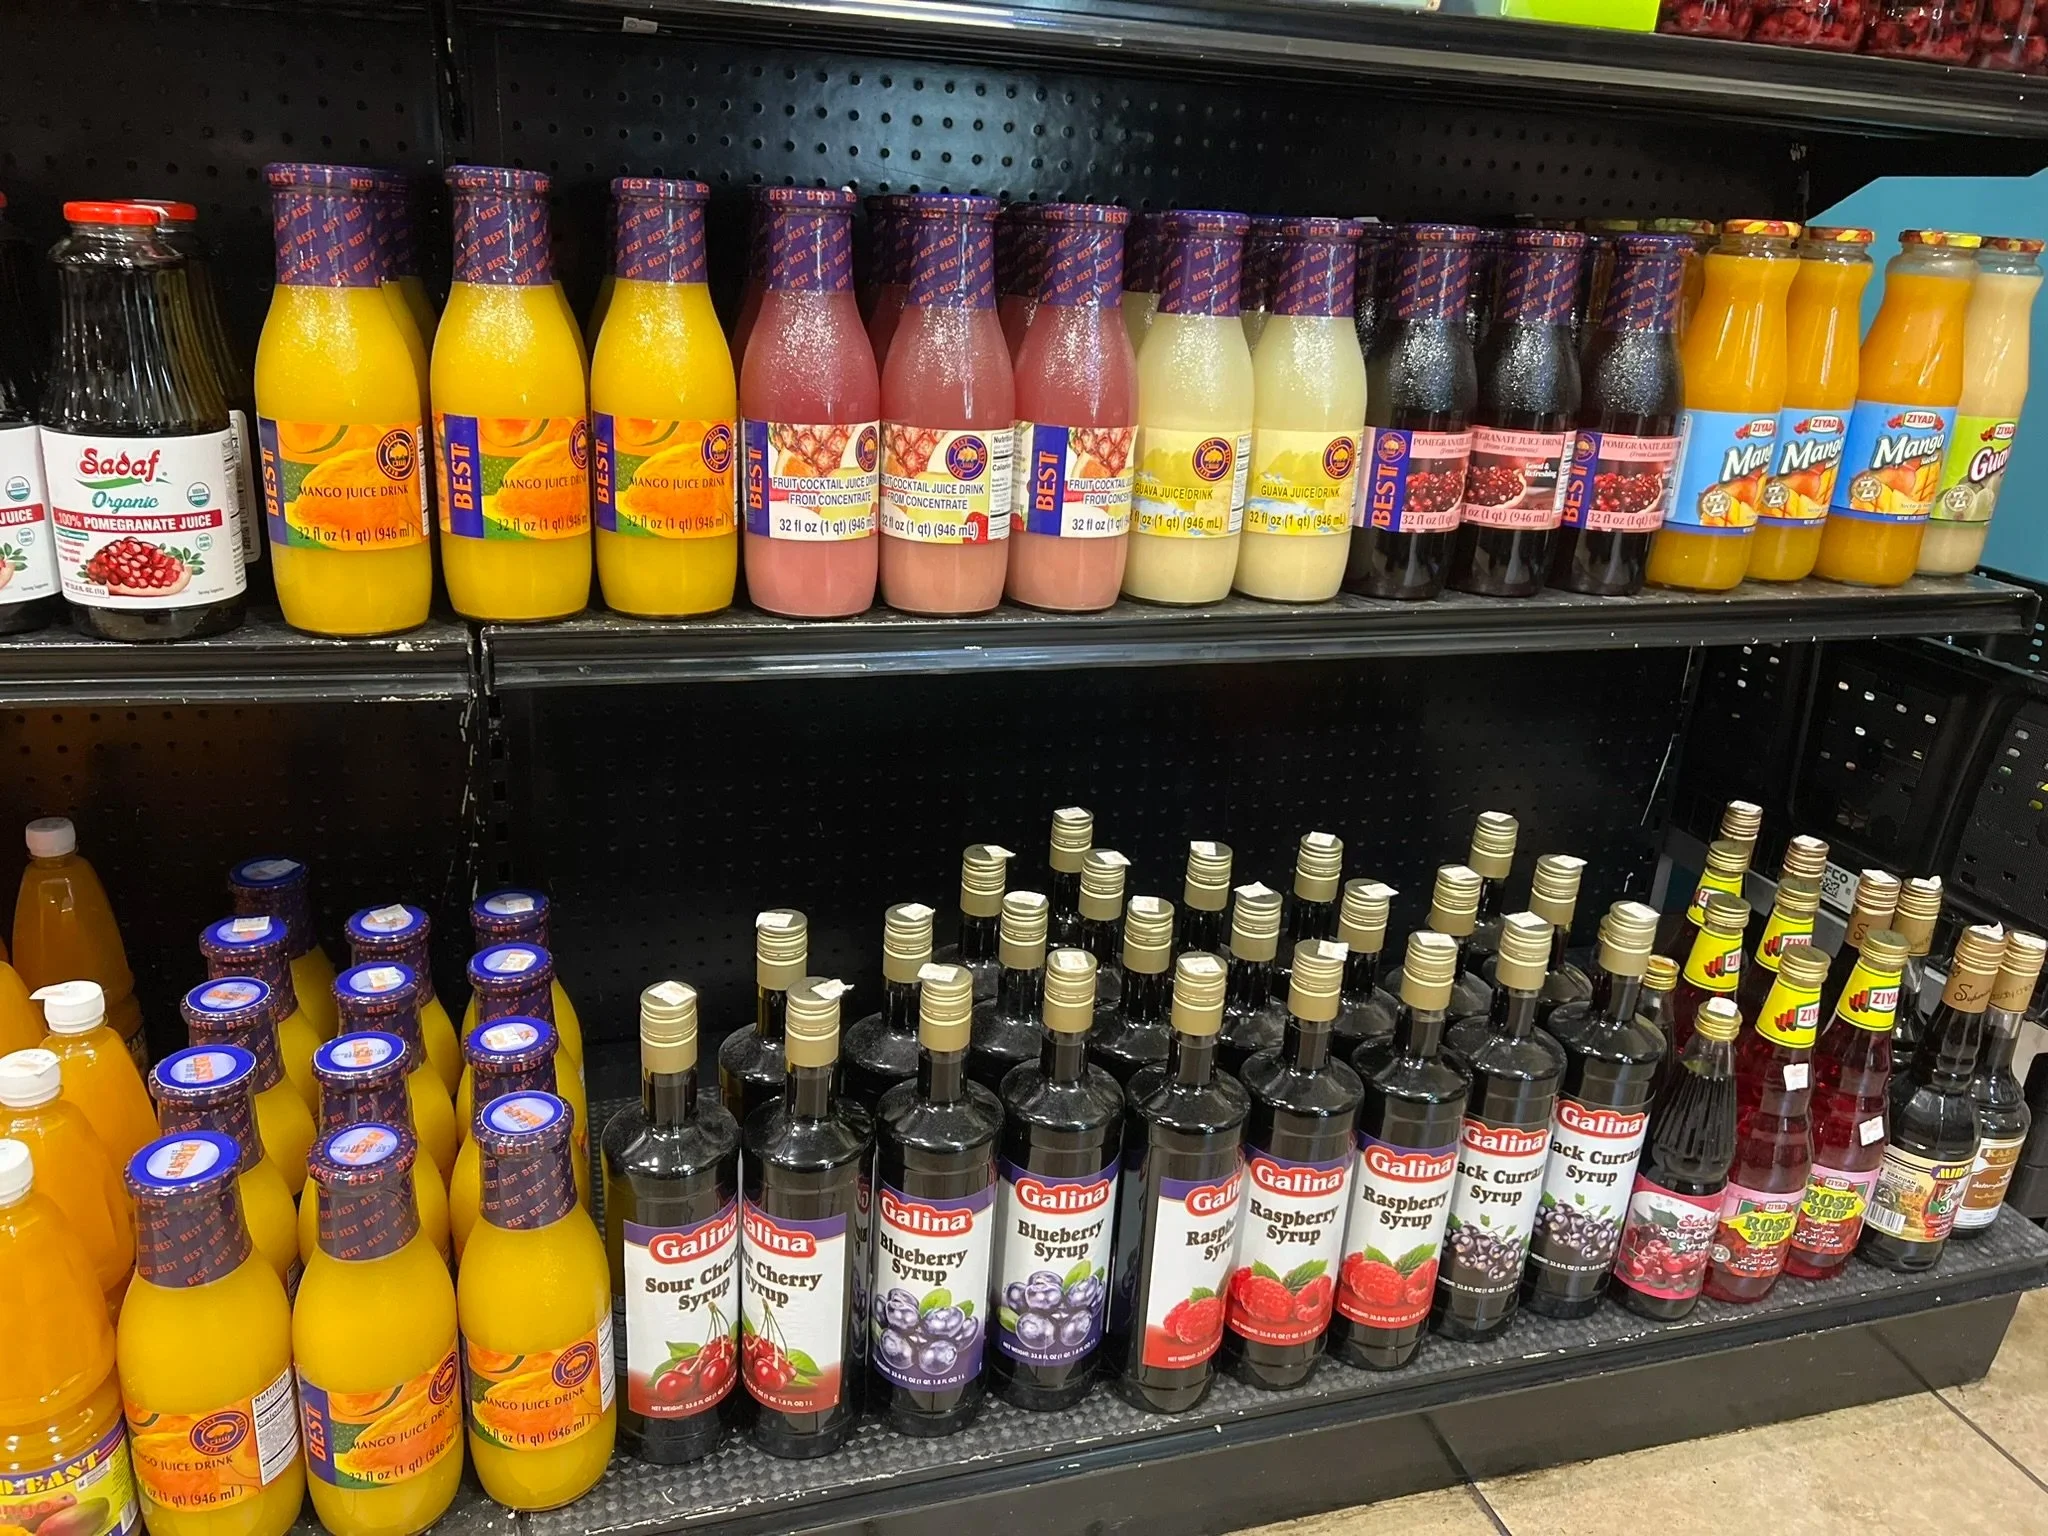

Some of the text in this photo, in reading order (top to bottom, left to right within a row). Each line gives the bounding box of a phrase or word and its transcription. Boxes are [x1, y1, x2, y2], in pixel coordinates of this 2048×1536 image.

[345, 205, 362, 222] BEST
[296, 228, 318, 246] BEST
[348, 231, 366, 248] BEST
[1752, 423, 1773, 432] ZIYAD
[1811, 418, 1837, 428] ZIYAD
[1906, 414, 1935, 424] ZIYAD
[1518, 436, 1564, 447] JUICE DRINK
[1602, 440, 1659, 450] POMEGRANATE
[1872, 433, 1945, 469] Mango
[80, 448, 160, 482] Sadaf
[596, 438, 610, 505] BEST
[1524, 469, 1558, 480] Refreshing
[1525, 462, 1551, 470] Good &
[261, 447, 279, 517] BEST
[451, 442, 475, 511] BEST
[499, 474, 586, 490] MANGO JUICE DRIN
[629, 476, 725, 490] MANGO JUICE DRINK
[749, 449, 763, 510] BEST
[772, 477, 797, 489] FRUIT
[799, 477, 843, 490] COCKTAIL
[844, 477, 865, 489] JUICE
[893, 477, 930, 493] COCKTAIL
[931, 481, 958, 495] JUICE
[958, 482, 985, 495] DRINK
[1035, 450, 1059, 513] BEST
[1068, 477, 1092, 490] FRUIT
[1094, 477, 1126, 491] COCKTAIL
[92, 490, 159, 514] Organic
[298, 484, 409, 500] MANGO JUICE DRINK
[789, 491, 871, 505] FROM CONCENTRATE
[887, 491, 968, 510] FROM CONCENTRATE
[1084, 493, 1107, 505] FROM
[1135, 482, 1158, 499] GUAVA
[1160, 485, 1185, 500] JUICE
[1187, 487, 1213, 501] DRINK
[1261, 484, 1340, 499] GUAVA JUICE DRINK
[1371, 463, 1399, 526] BEST
[1563, 464, 1588, 523] BEST
[58, 512, 212, 532] 100% POMEGRANATE JUICE
[1141, 514, 1152, 527] oz
[1154, 513, 1163, 528] (1
[1166, 514, 1180, 530] qt)
[1183, 514, 1204, 531] (946
[1205, 515, 1223, 531] mL)
[1467, 508, 1480, 517] oz
[1481, 507, 1490, 519] (1
[1492, 508, 1507, 522] qt)
[1509, 508, 1532, 522] (946
[298, 526, 310, 540] 32
[313, 526, 321, 541] fl
[324, 531, 337, 541] oz
[341, 527, 351, 543] (1
[356, 527, 371, 545] qt)
[375, 526, 397, 541] (946
[1871, 988, 1897, 1005] ZIYA
[1560, 1105, 1644, 1135] Galina
[1463, 1125, 1545, 1153] Galina
[1549, 1134, 1641, 1166] lack Curran
[1369, 1150, 1453, 1180] Galina
[1457, 1161, 1492, 1182] ack
[1255, 1163, 1341, 1193] Galina
[1565, 1165, 1618, 1187] Syrup
[1826, 1179, 1849, 1188] ZIYAD
[1020, 1184, 1108, 1210] Galina
[1362, 1184, 1449, 1214] Raspberry
[1470, 1184, 1522, 1206] Syrup
[1806, 1188, 1858, 1211] ROSE
[881, 1196, 967, 1233] Galina
[1249, 1198, 1339, 1229] Raspberry
[1379, 1210, 1433, 1230] Syrup
[1807, 1205, 1848, 1219] SYRUP
[742, 1210, 811, 1255] alina
[1017, 1218, 1105, 1245] Blueberry
[1659, 1226, 1692, 1240] Sour
[1743, 1215, 1792, 1232] ROSE
[656, 1210, 738, 1259] Galina
[1266, 1224, 1321, 1245] Syrup
[1749, 1231, 1785, 1242] SYRUP
[880, 1231, 969, 1268] Blueberry
[1033, 1242, 1090, 1262] Syrup
[1678, 1240, 1709, 1252] Syrup
[757, 1261, 824, 1291] Cherry
[891, 1258, 947, 1286] Syrup
[645, 1275, 695, 1294] Sour
[678, 1276, 730, 1312] Syrup
[745, 1268, 790, 1309] Syrup
[254, 1373, 288, 1405] Nutrition
[483, 1387, 586, 1412] MANGO JUICE DRINK
[305, 1403, 327, 1462] BEST
[351, 1401, 455, 1449] MANGO JUICE DRINK
[492, 1427, 501, 1441] fl
[501, 1432, 514, 1443] oz
[516, 1430, 527, 1445] (1
[529, 1430, 546, 1448] qt)
[547, 1422, 572, 1443] (946
[25, 1448, 99, 1494] EAST
[160, 1454, 234, 1472] JUICE DRINK
